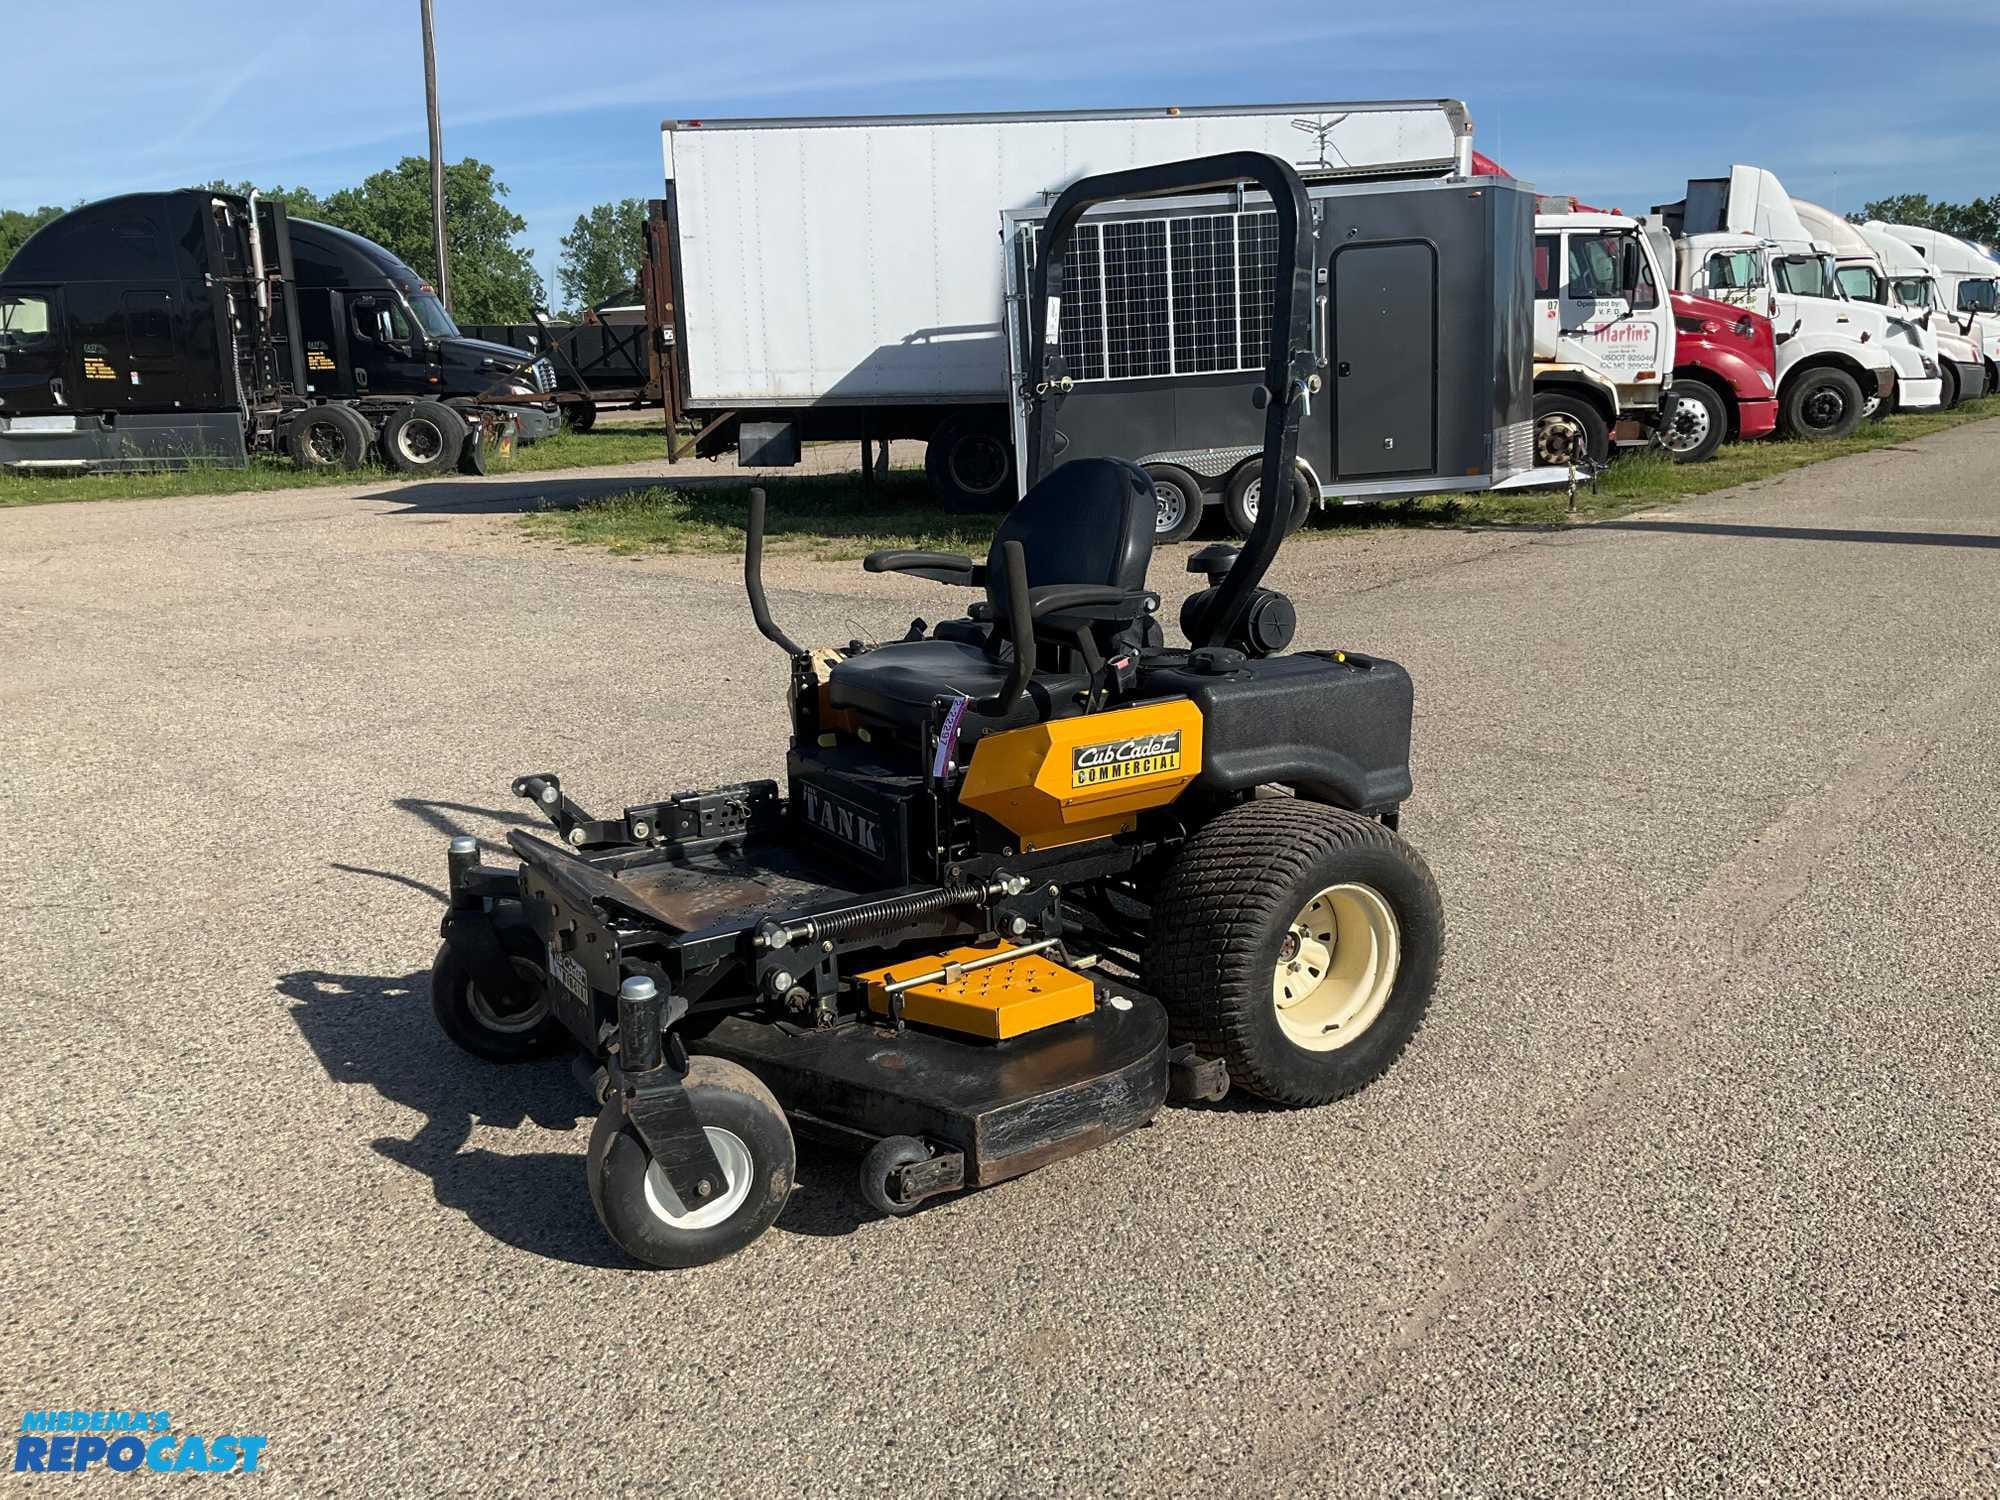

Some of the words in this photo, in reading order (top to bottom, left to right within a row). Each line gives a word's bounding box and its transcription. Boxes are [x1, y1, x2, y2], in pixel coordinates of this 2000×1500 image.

[1548, 301, 1558, 310] 07
[1594, 323, 1650, 343] Martin's
[1077, 745, 1114, 768] Cub
[1115, 736, 1177, 761] Cadet
[1077, 754, 1176, 784] COMMERCIAL
[802, 784, 878, 853] TANK
